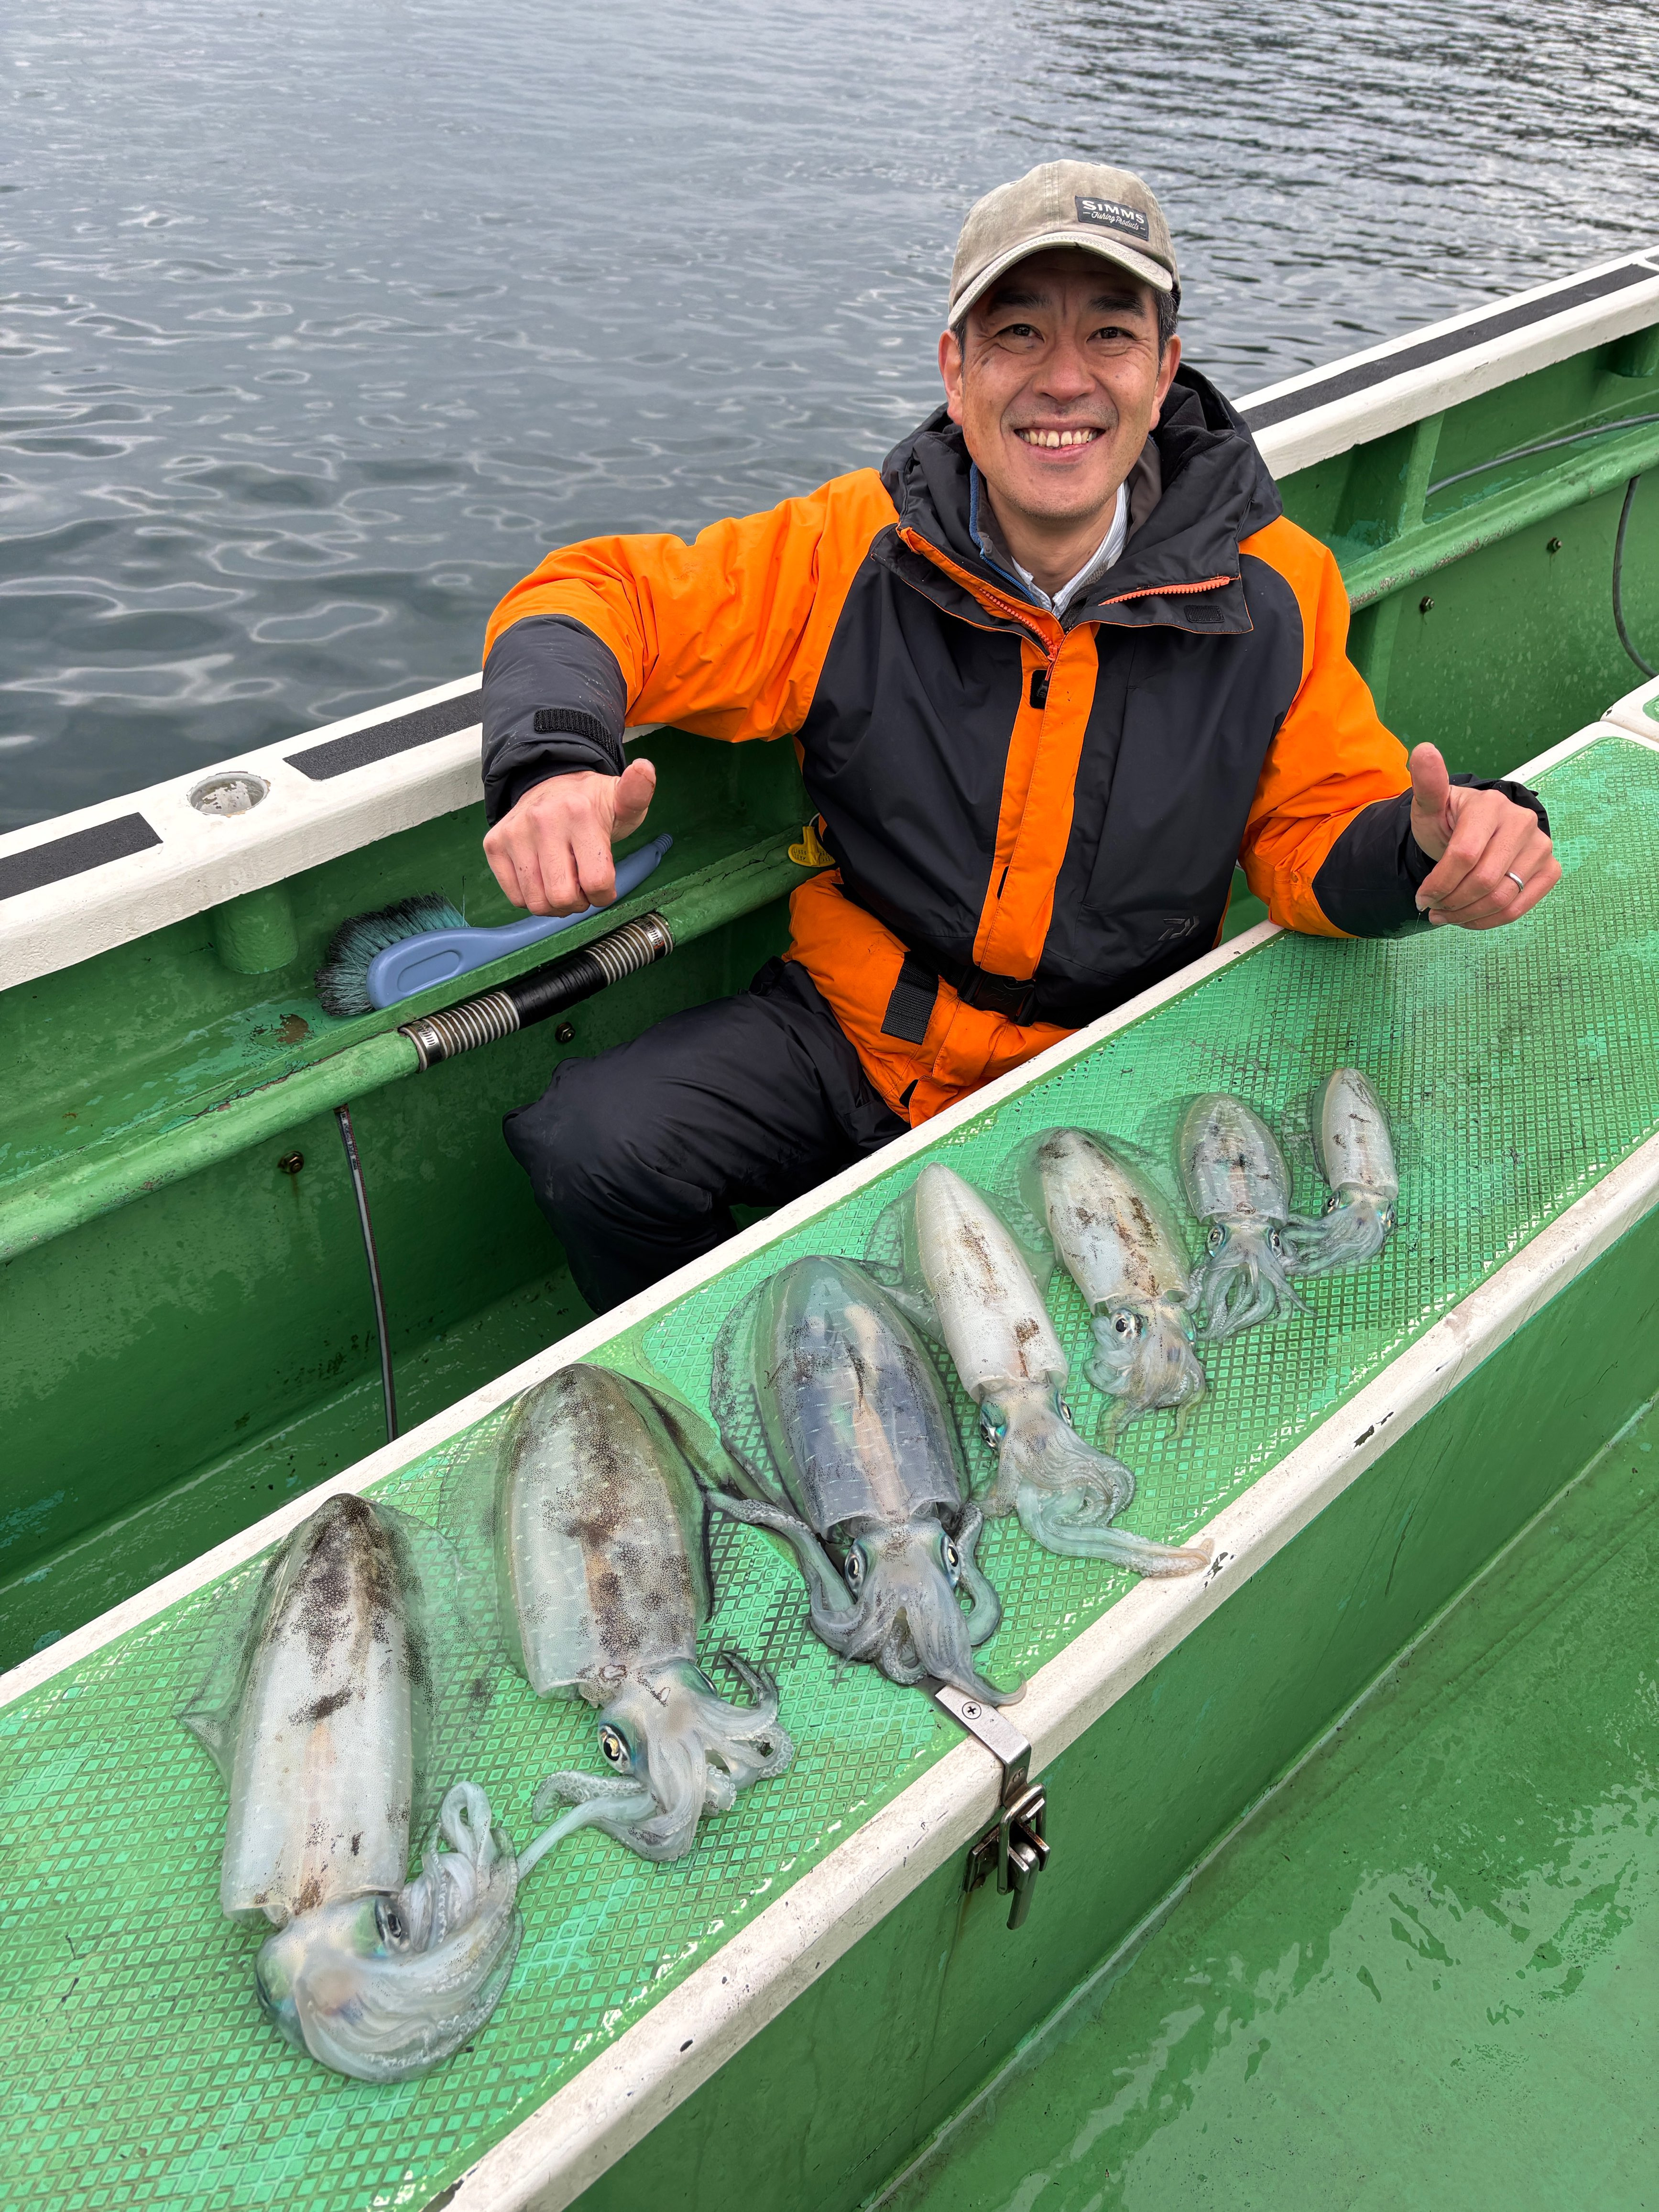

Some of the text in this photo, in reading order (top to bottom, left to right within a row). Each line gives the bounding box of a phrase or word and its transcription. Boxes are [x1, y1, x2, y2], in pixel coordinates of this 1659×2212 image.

[1082, 200, 1145, 224] SIMMS
[1091, 211, 1139, 230] Fishing Products
